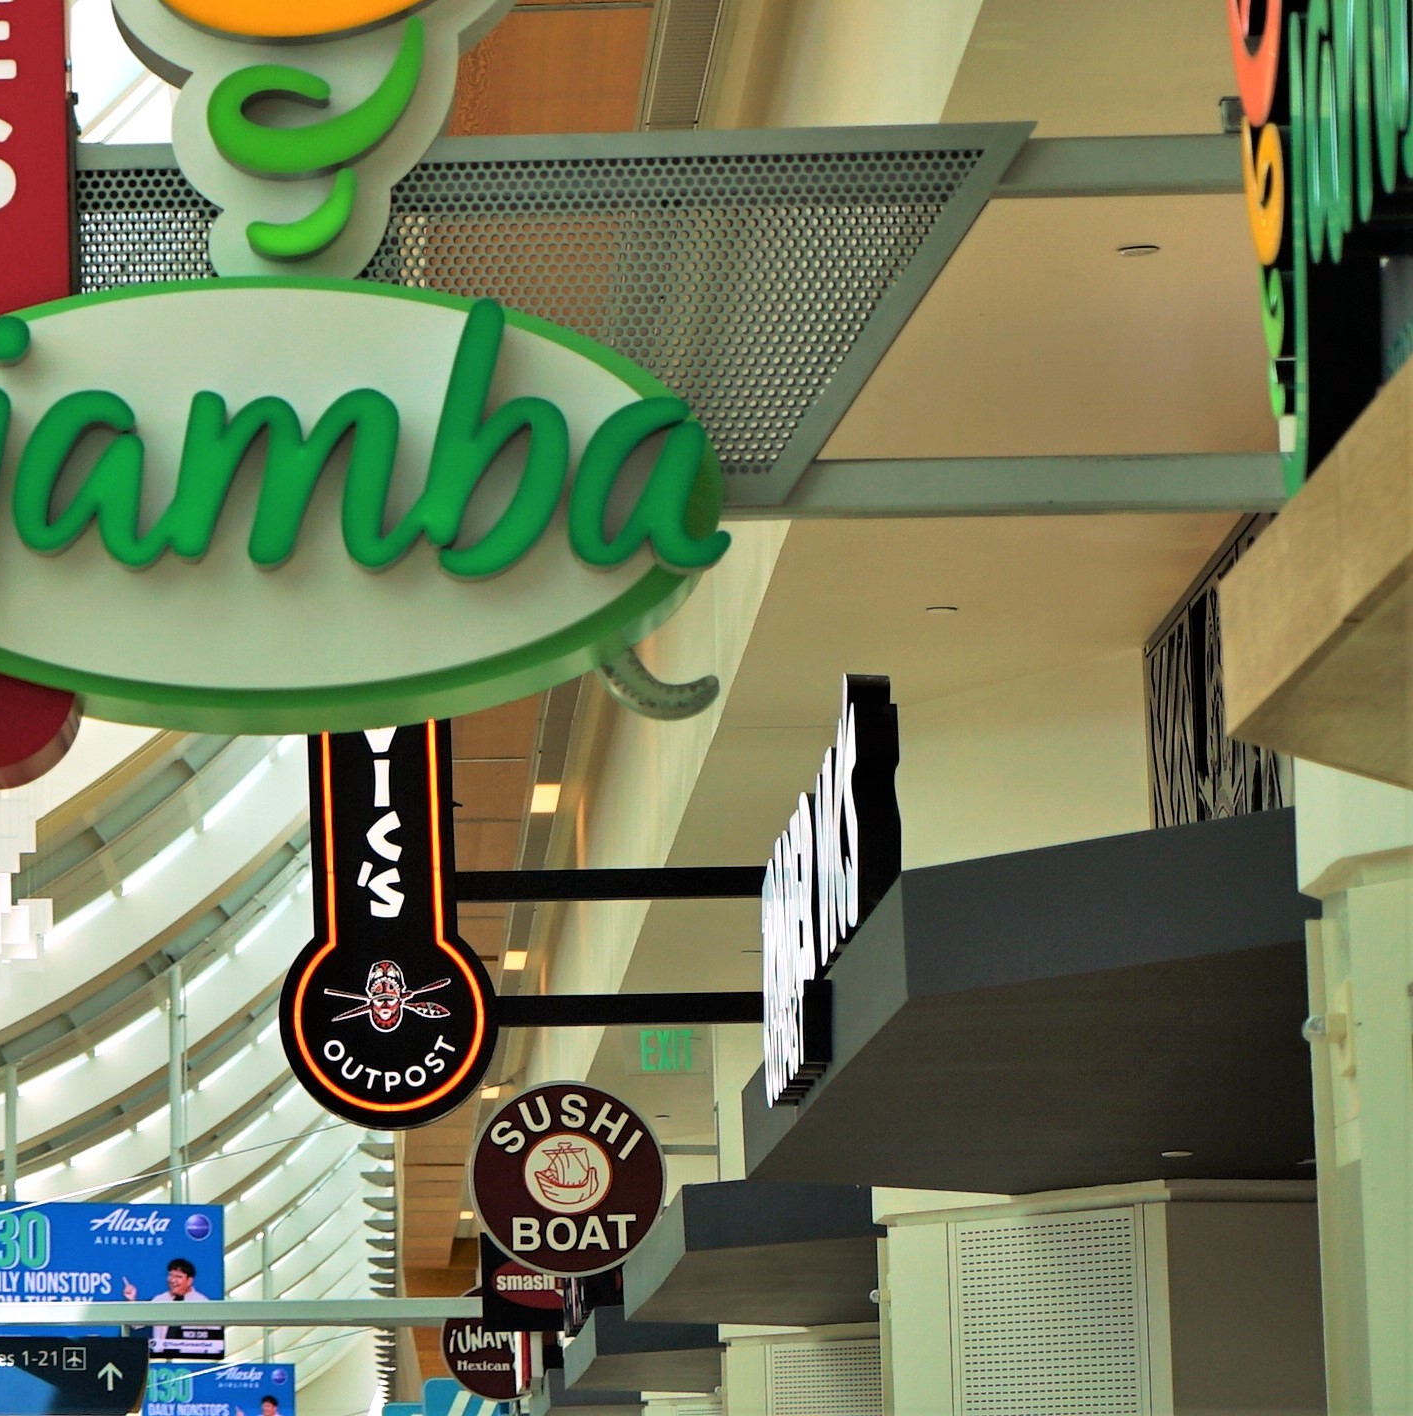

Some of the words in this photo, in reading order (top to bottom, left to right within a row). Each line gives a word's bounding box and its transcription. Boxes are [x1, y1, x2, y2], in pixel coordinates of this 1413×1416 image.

[814, 672, 859, 967] VIC'S
[323, 1035, 456, 1093] OUTPOST
[640, 1030, 693, 1071] EXIT
[490, 1093, 644, 1161] SUSHI
[89, 1208, 171, 1235] Alaska
[511, 1213, 637, 1252] BOAT
[94, 1236, 164, 1246] AIRLINES
[24, 1271, 112, 1295] NONSTOPS
[495, 1273, 556, 1291] smash
[22, 1350, 58, 1366] 1-21
[456, 1359, 511, 1372] Mexican
